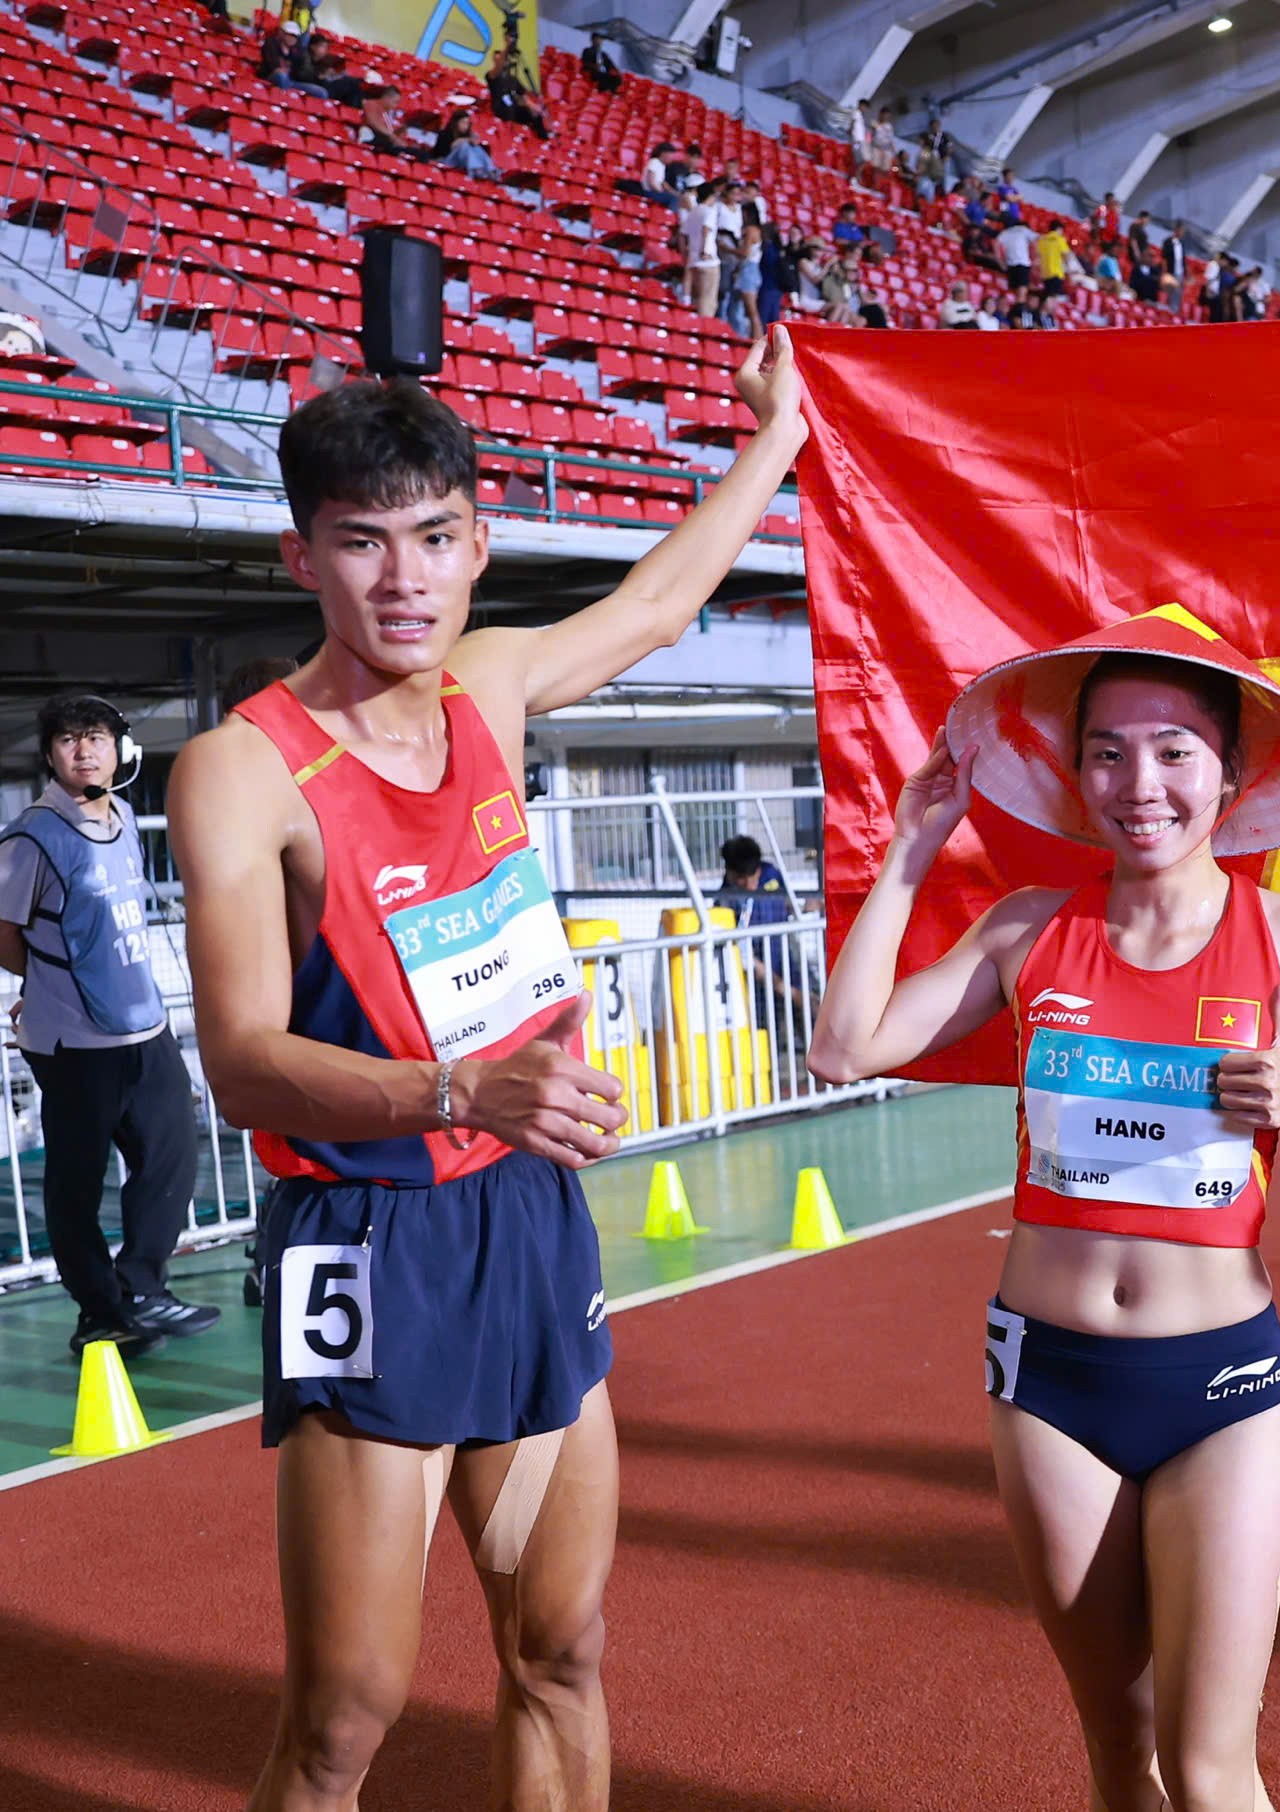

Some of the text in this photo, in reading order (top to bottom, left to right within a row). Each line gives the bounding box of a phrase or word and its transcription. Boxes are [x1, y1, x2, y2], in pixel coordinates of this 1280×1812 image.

[112, 899, 143, 931] HB
[395, 912, 431, 960] 33rd
[435, 908, 480, 944] SEA
[451, 950, 510, 992] TUONG
[533, 973, 565, 999] 296
[1028, 1011, 1091, 1025] LI-NING
[434, 1021, 486, 1053] THAILAND
[1044, 1044, 1217, 1093] 33rd SEA GAME
[1095, 1117, 1166, 1141] HANG
[1051, 1164, 1110, 1185] THAILAND
[1195, 1181, 1233, 1197] 649
[304, 1263, 363, 1360] 5
